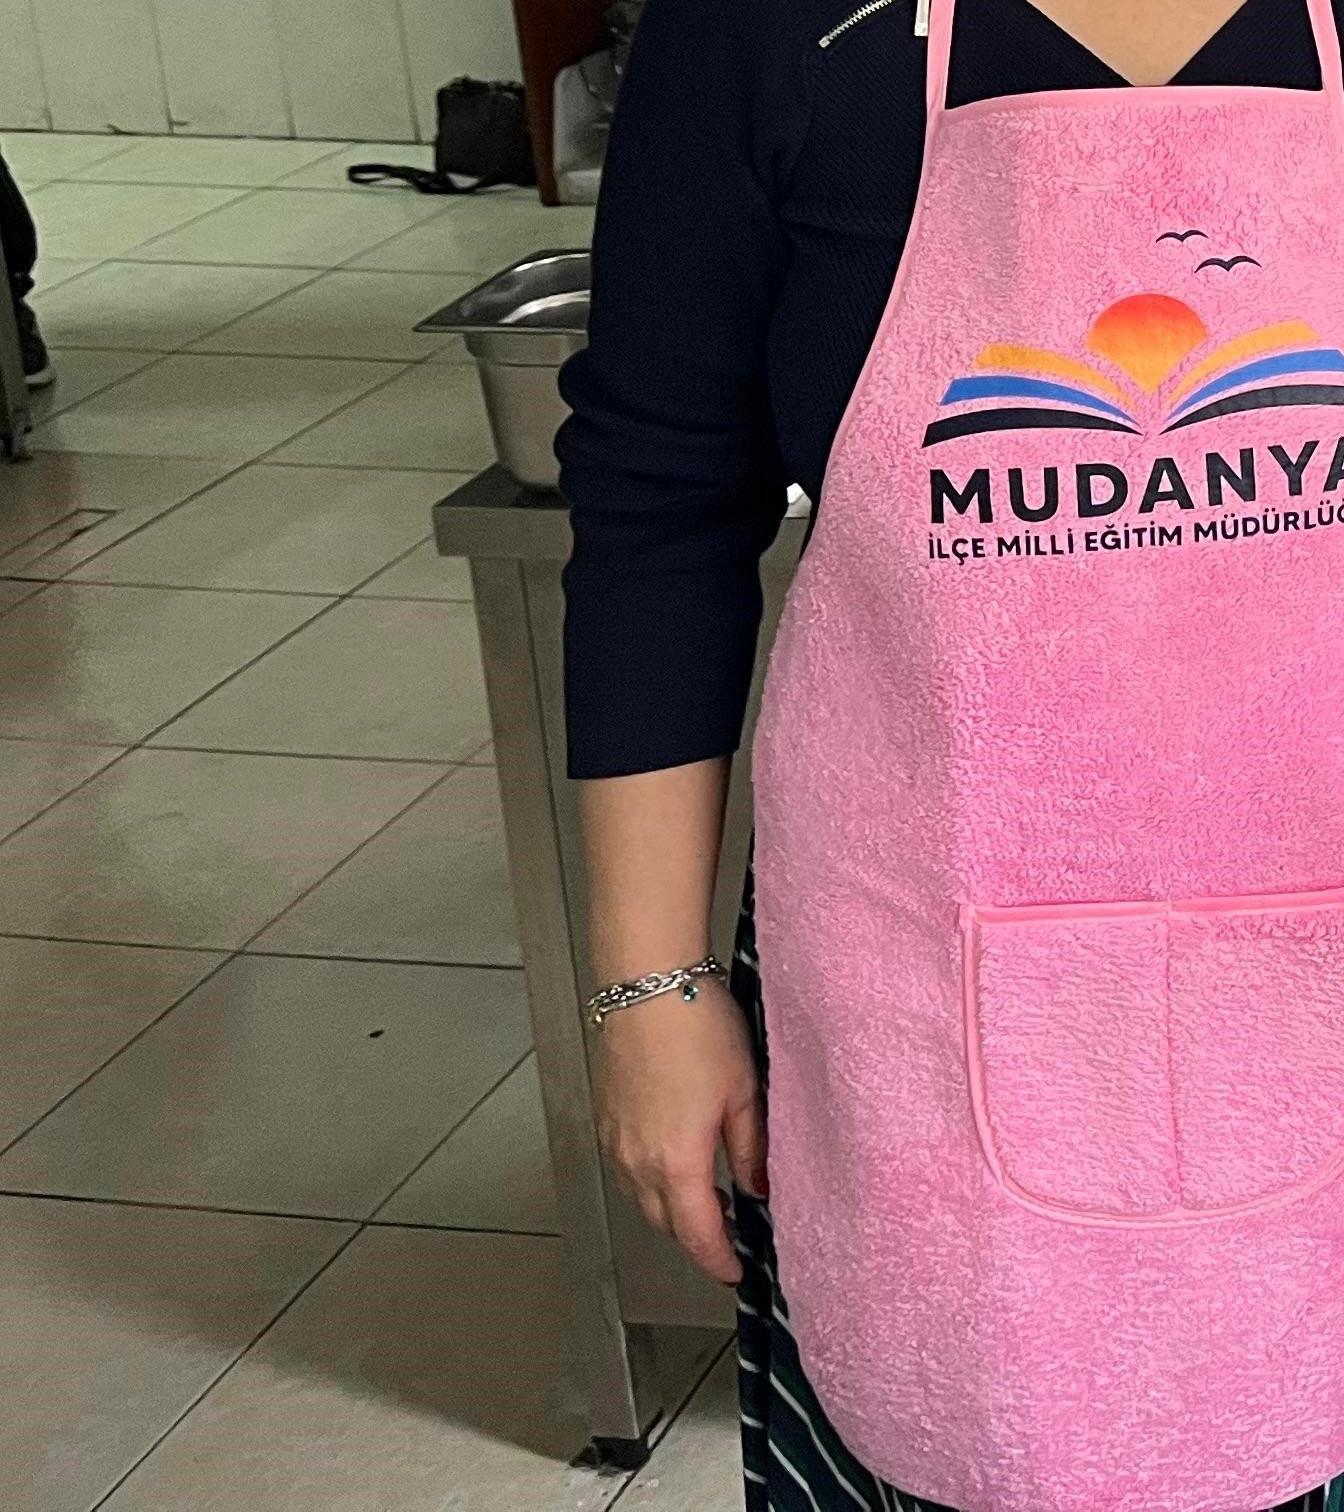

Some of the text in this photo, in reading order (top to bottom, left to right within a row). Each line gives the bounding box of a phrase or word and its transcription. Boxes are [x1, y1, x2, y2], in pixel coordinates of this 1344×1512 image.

[928, 532, 986, 566] İLÇE
[997, 528, 1075, 557] MİLLİ
[1084, 520, 1183, 552] EĞİTİM
